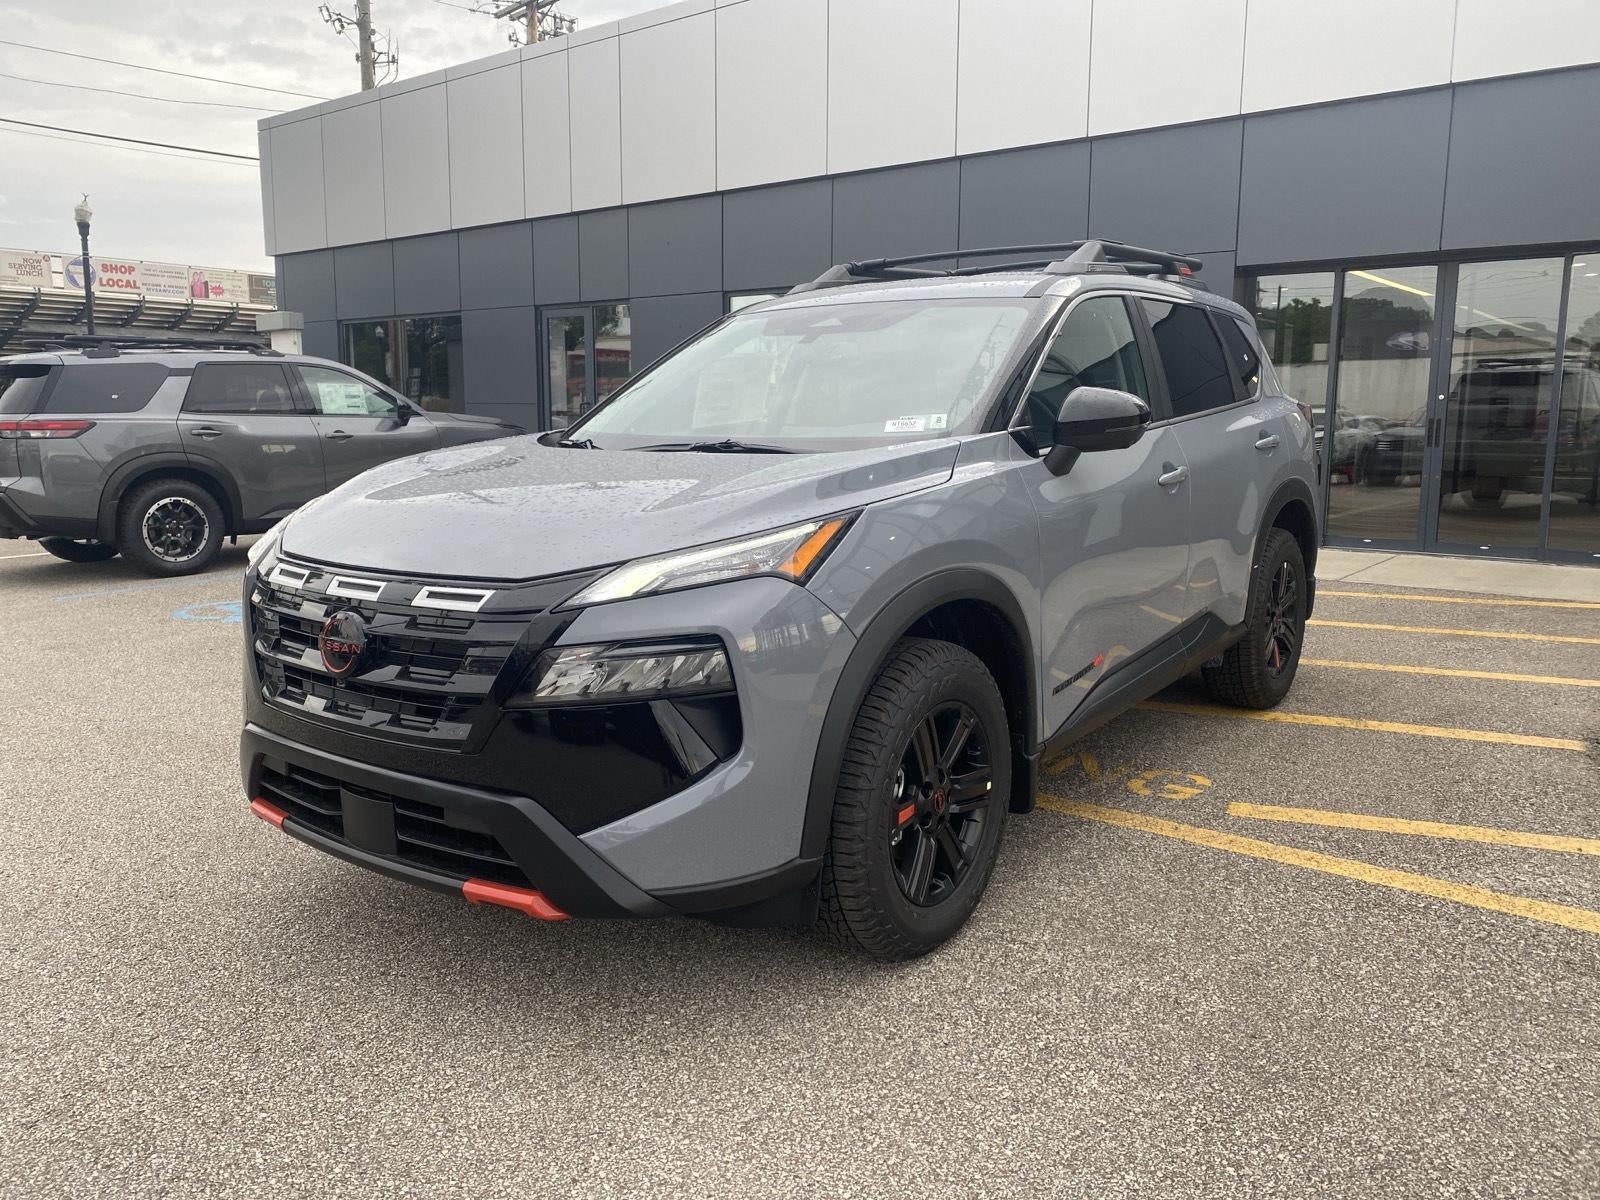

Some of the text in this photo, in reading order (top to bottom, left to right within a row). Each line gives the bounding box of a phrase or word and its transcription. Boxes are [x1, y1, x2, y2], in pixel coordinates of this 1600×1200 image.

[8, 262, 43, 271] SERVING
[101, 263, 135, 275] SHOP
[16, 269, 43, 277] LUNCH
[99, 277, 141, 289] LOCAL
[318, 637, 361, 654] SSAN
